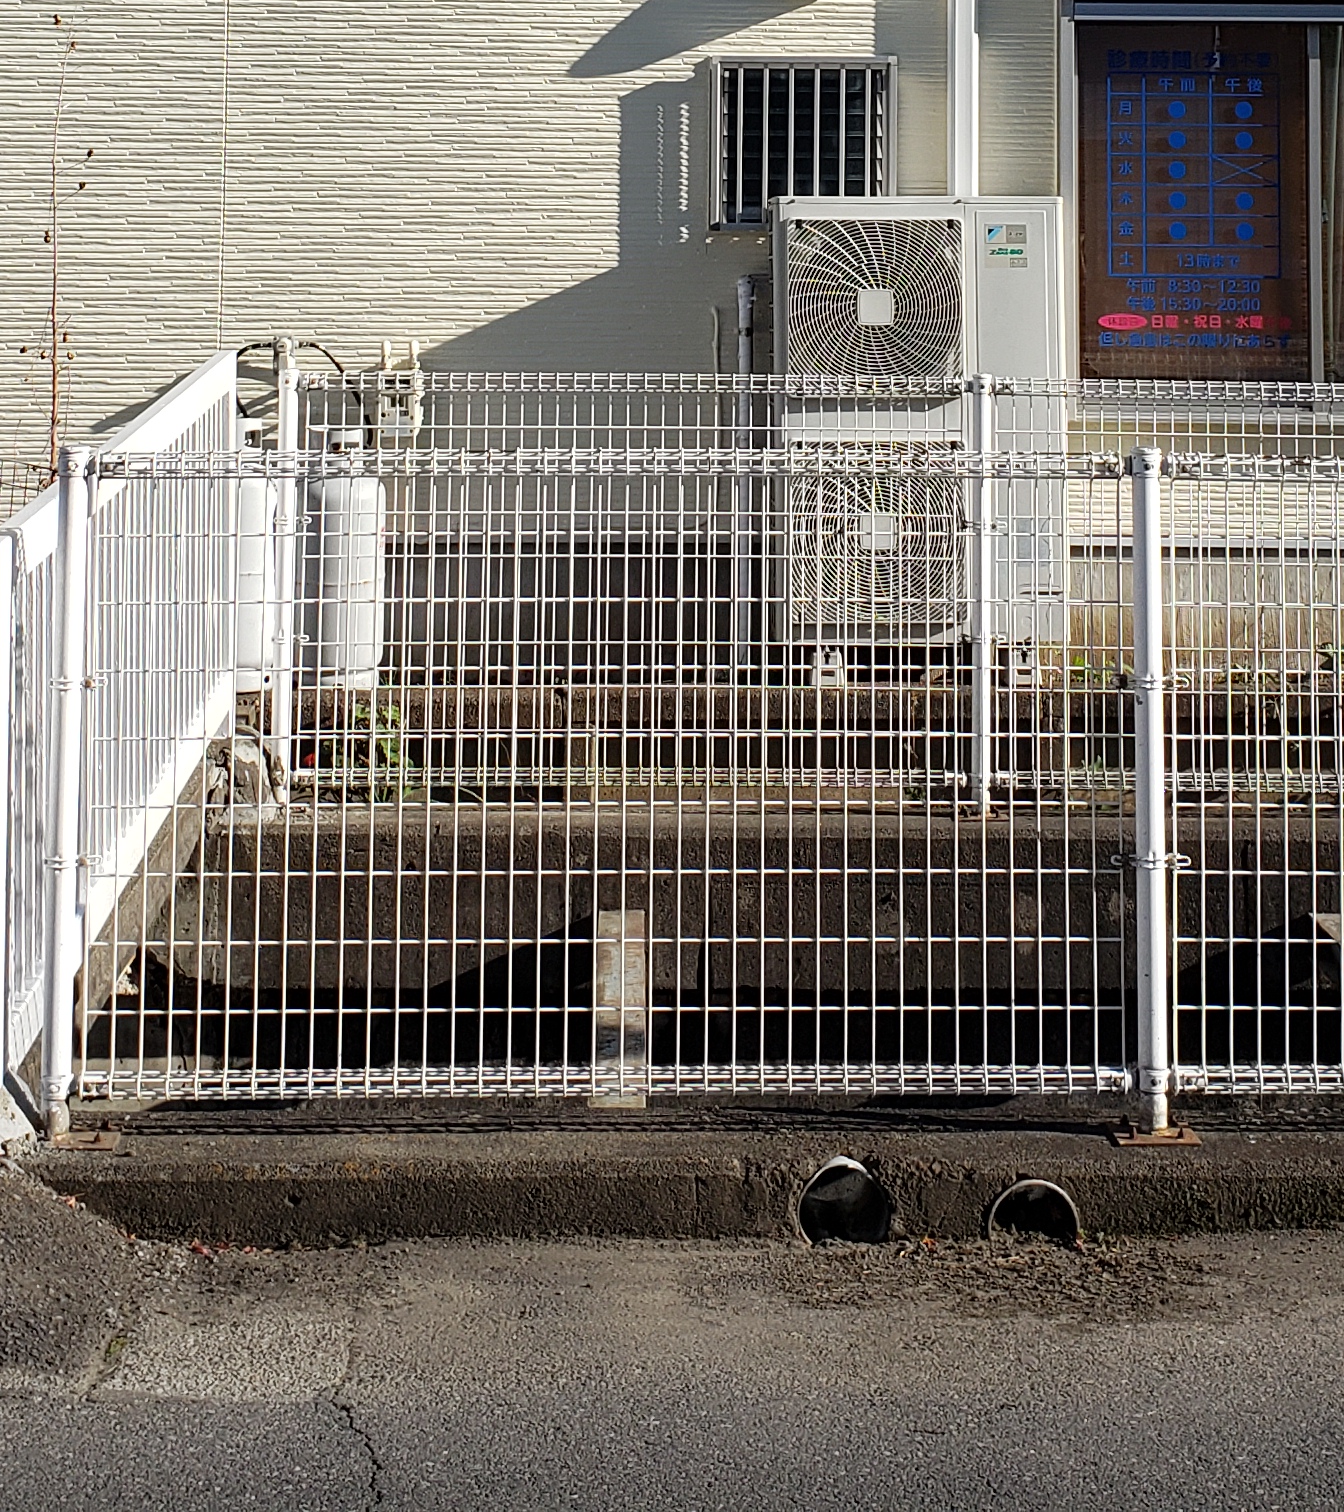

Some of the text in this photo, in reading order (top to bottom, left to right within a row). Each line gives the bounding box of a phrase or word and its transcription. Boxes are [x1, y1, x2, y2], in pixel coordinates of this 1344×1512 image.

[1119, 100, 1133, 116] 月
[1118, 130, 1134, 146] 火
[1118, 160, 1134, 175] 水
[1119, 191, 1134, 206] 木
[1119, 221, 1135, 237] 金
[1120, 251, 1134, 267] 土
